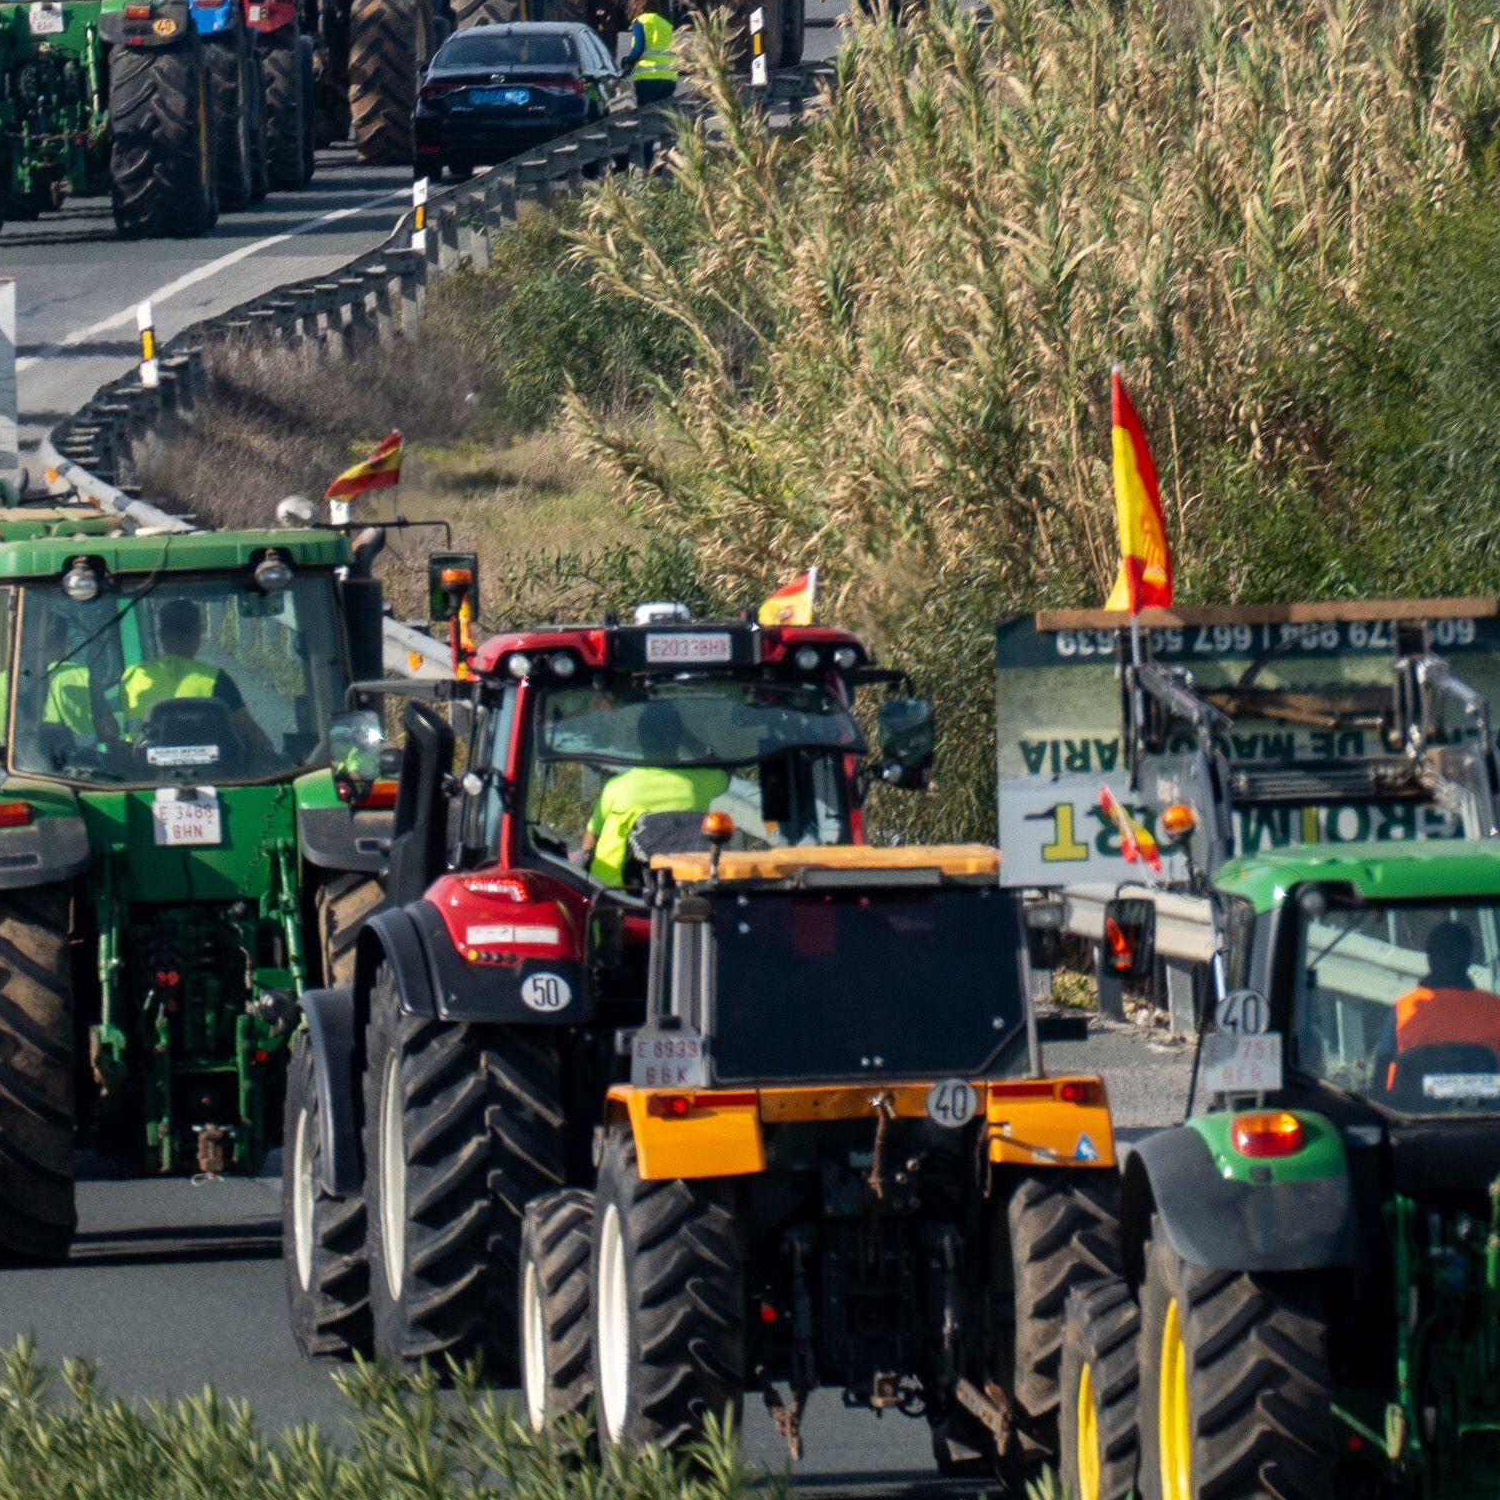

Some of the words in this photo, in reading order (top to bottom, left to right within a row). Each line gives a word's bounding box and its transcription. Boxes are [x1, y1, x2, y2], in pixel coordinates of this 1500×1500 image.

[1055, 627, 1118, 657] 639
[159, 806, 169, 821] E
[532, 975, 561, 1008] 50
[1221, 994, 1260, 1034] 40
[935, 1084, 968, 1120] 40
